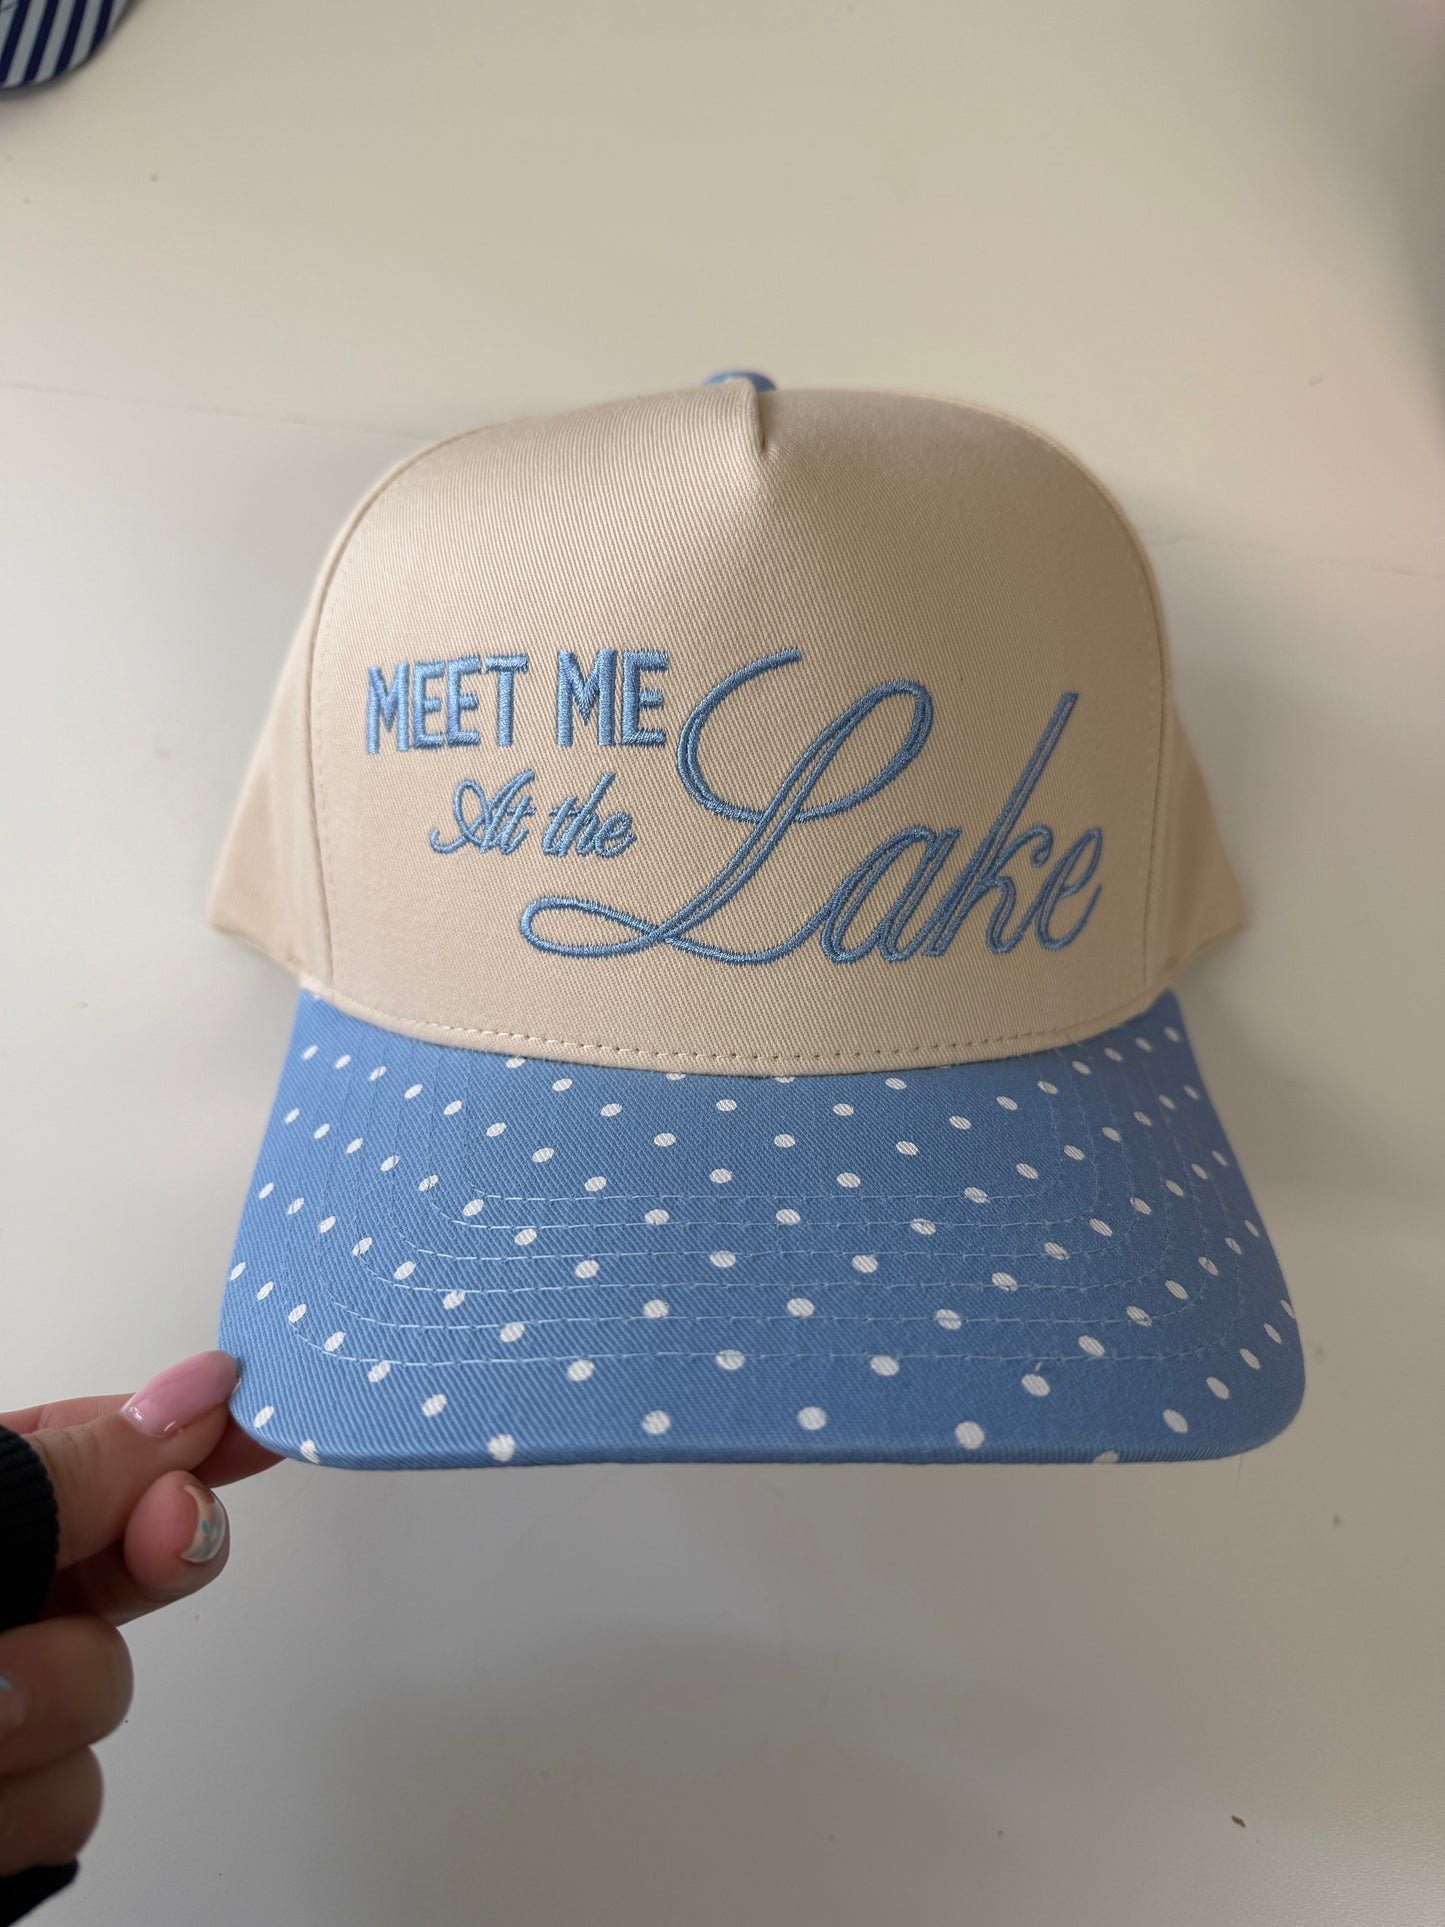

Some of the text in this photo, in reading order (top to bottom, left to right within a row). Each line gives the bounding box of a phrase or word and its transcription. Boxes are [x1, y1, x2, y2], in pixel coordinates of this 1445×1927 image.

[366, 648, 668, 755] MEET ME
[430, 770, 636, 858] At the
[520, 648, 1102, 966] Lake
